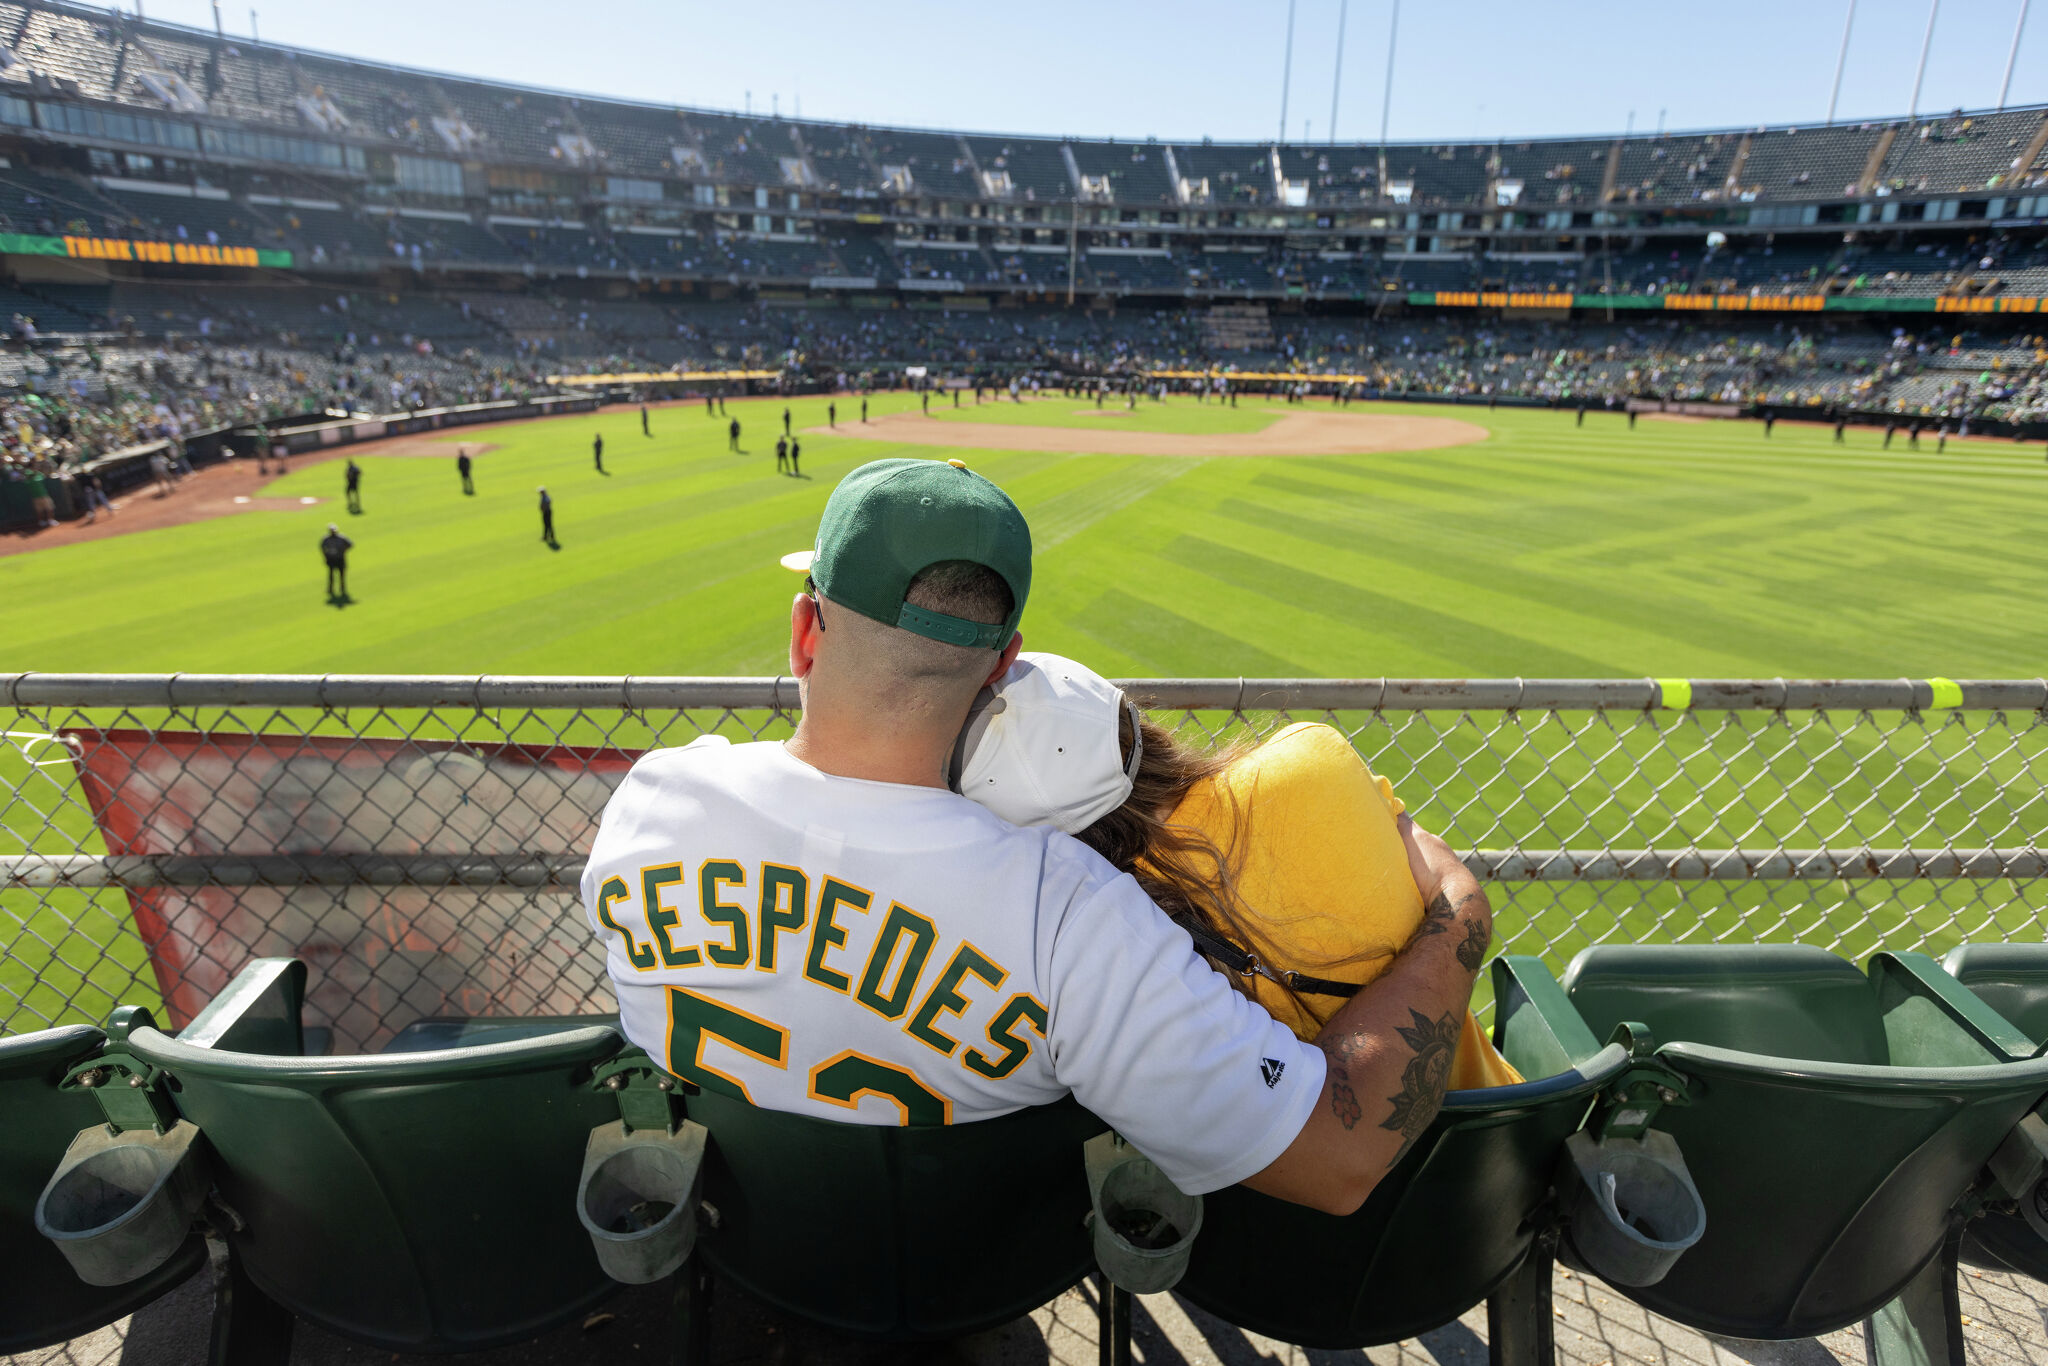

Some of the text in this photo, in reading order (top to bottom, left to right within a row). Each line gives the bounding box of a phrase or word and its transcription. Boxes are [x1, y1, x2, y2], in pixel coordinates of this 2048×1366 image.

[63, 235, 258, 266] THANK YOU OAKLAND
[1935, 296, 1995, 312] THANK
[2000, 297, 2038, 312] YOU
[598, 858, 1048, 1081] CESPEDES
[1267, 1062, 1286, 1089] Majestic
